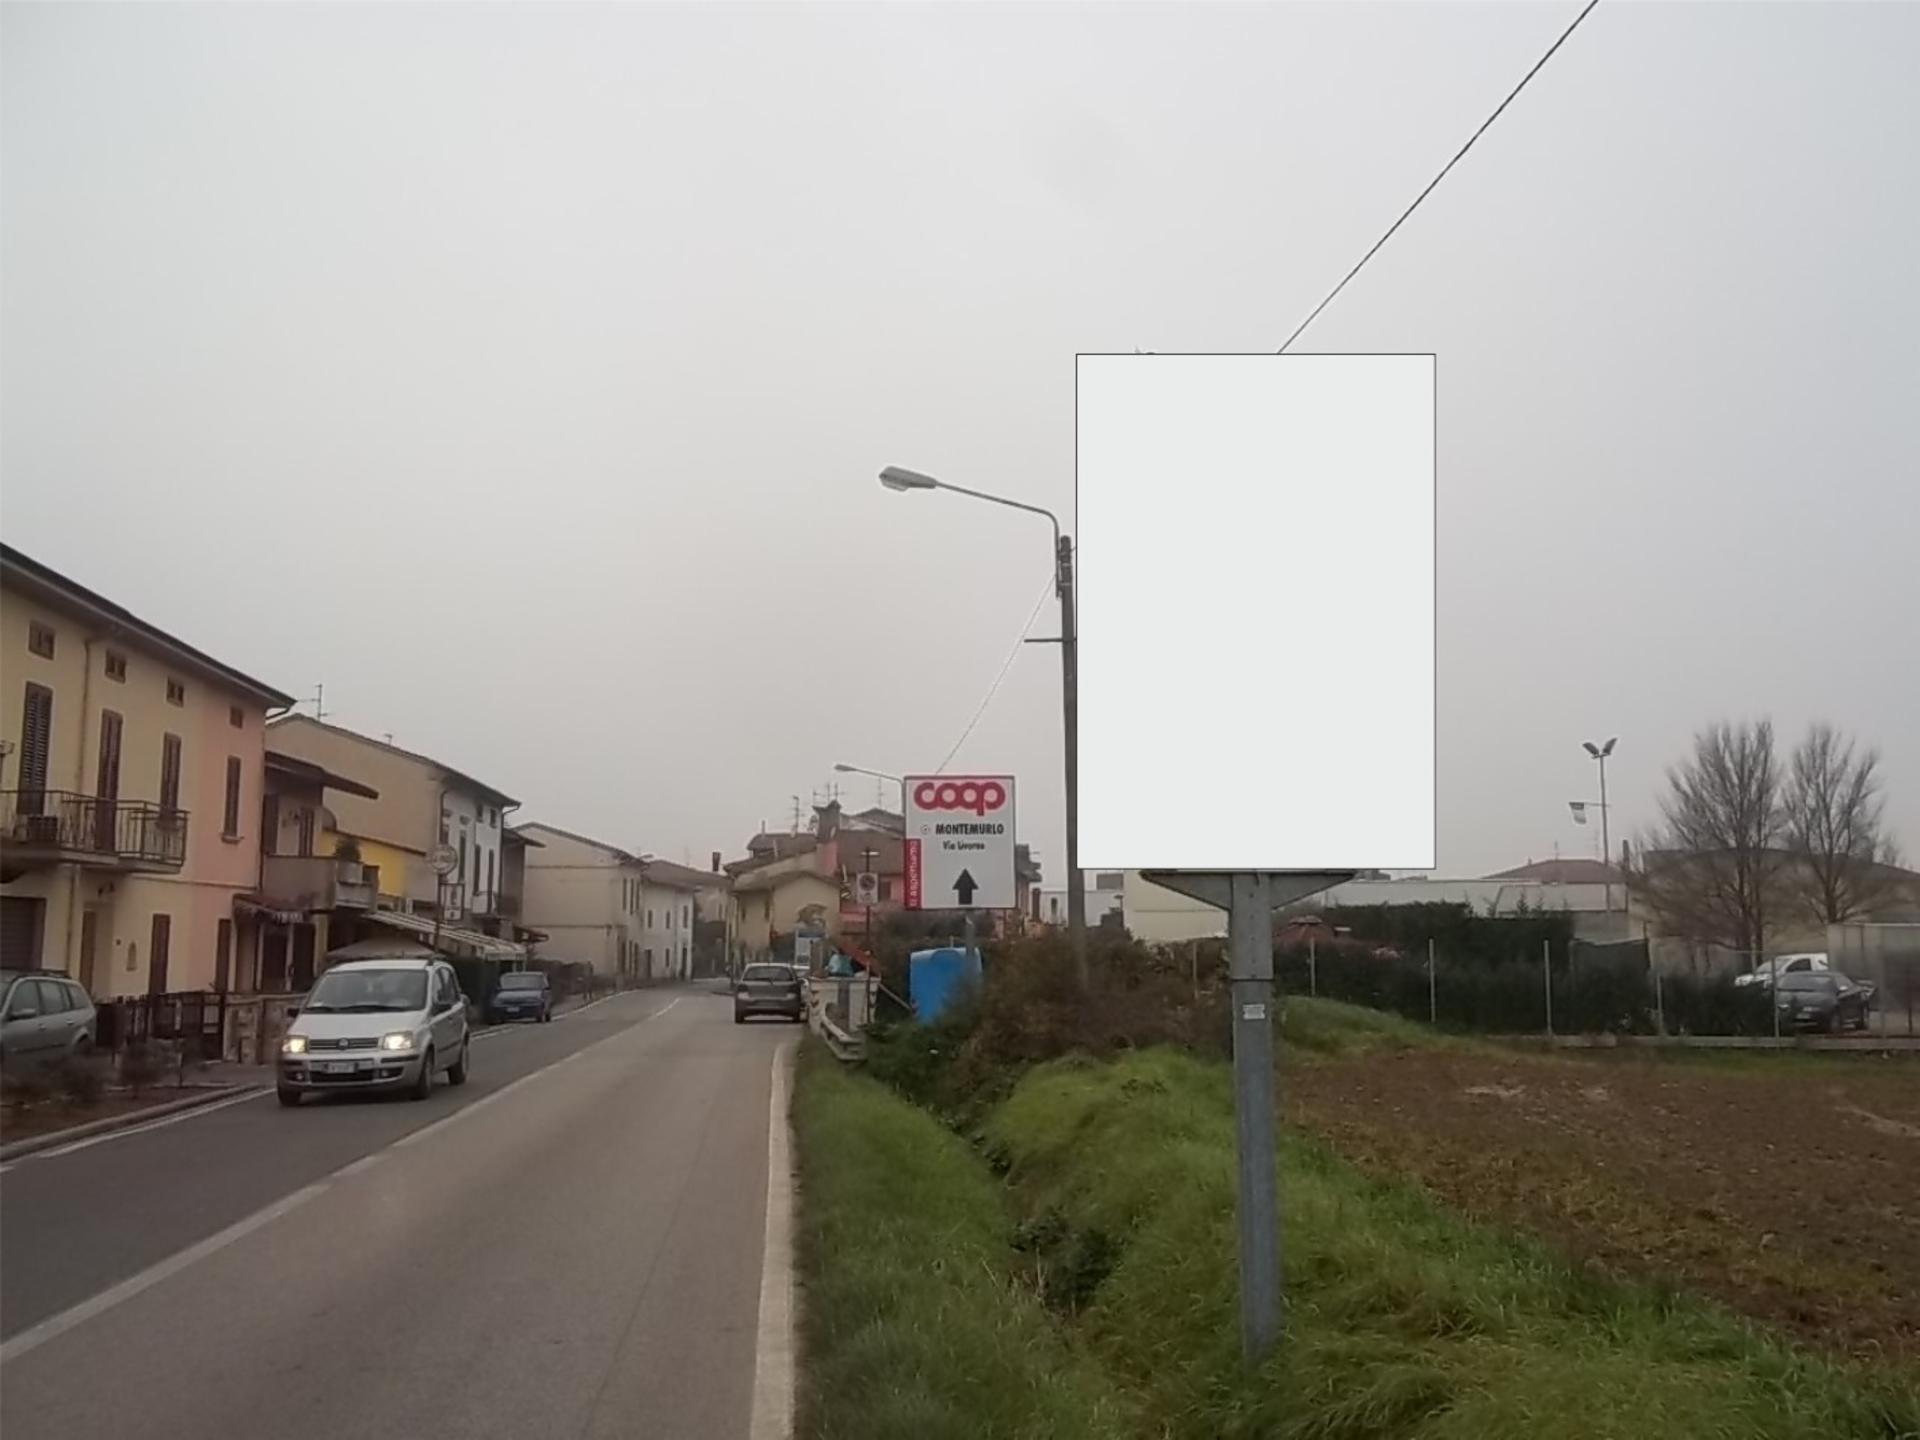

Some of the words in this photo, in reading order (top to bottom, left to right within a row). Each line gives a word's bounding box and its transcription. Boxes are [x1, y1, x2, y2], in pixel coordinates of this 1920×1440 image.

[914, 782, 1005, 816] coop
[935, 823, 1004, 835] MONTEMURLO
[943, 840, 955, 850] Via
